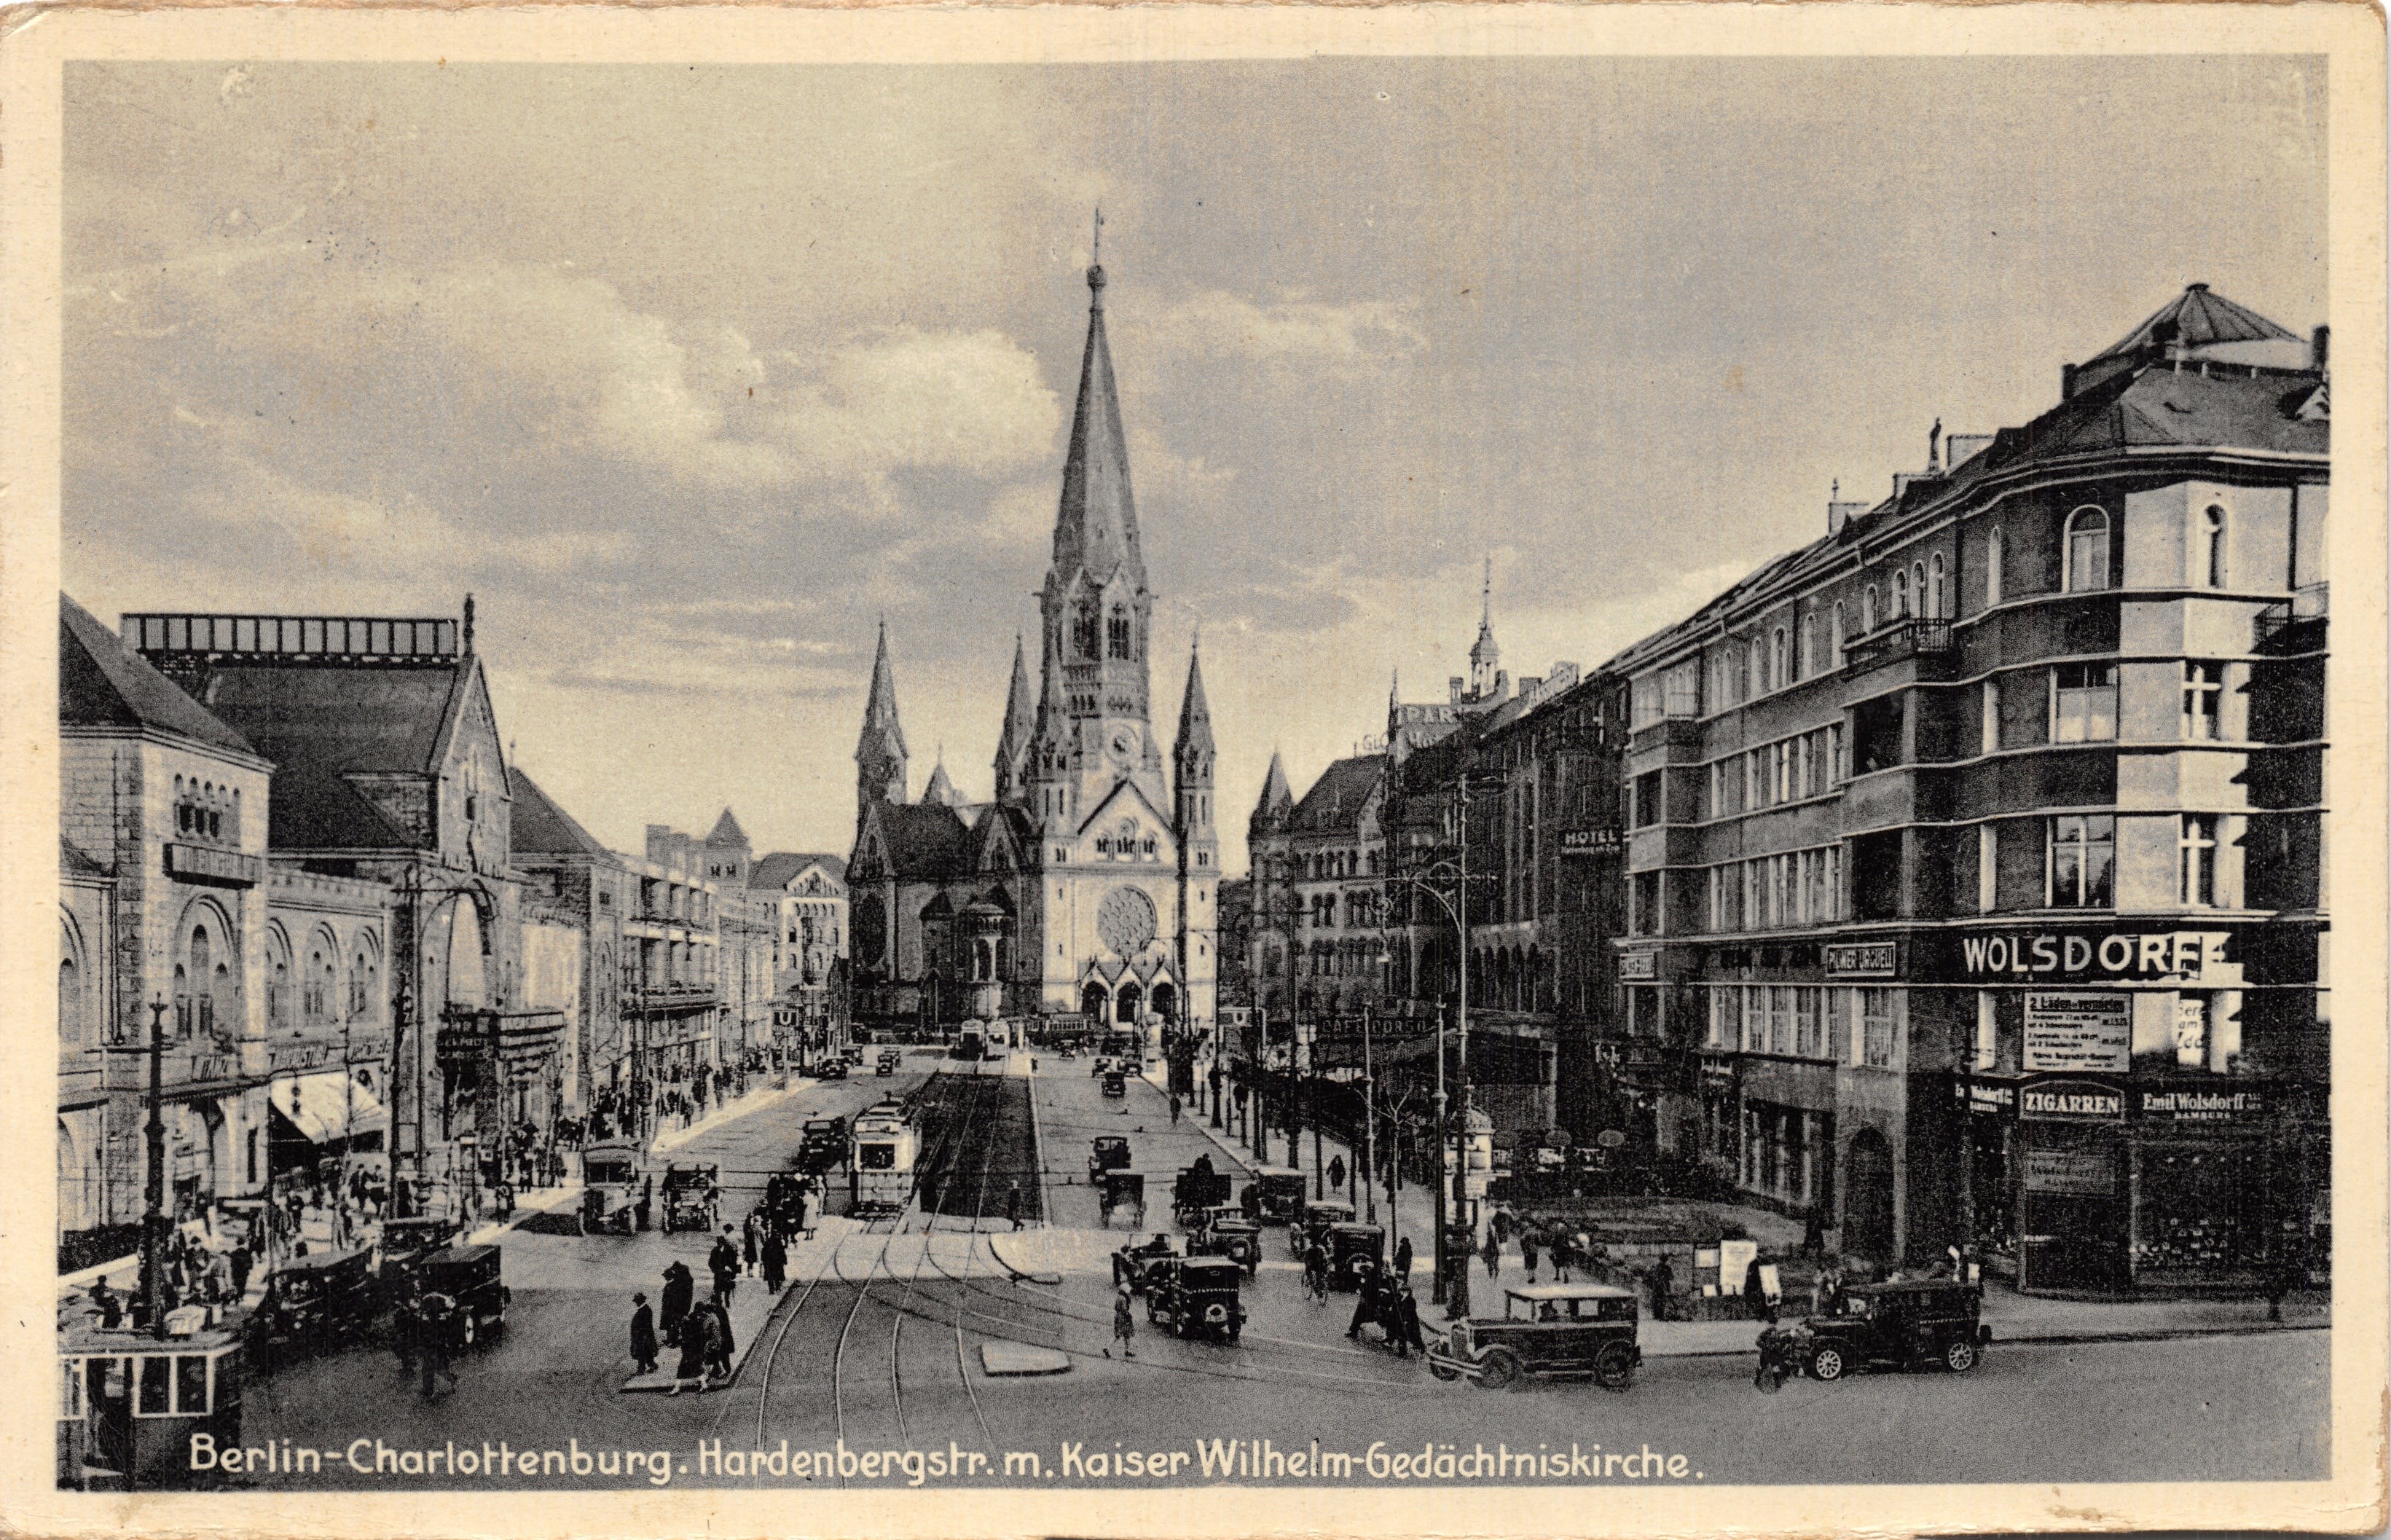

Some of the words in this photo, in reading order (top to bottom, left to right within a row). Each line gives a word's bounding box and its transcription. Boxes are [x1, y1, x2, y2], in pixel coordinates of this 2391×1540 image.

[1564, 828, 1617, 845] HOTEL
[1963, 932, 2231, 973] WOLSDORFF
[779, 1011, 792, 1026] U
[1233, 1012, 1247, 1026] U
[2025, 1093, 2119, 1114] ZIGARREN
[2143, 1092, 2175, 1111] Emil
[2176, 1092, 2245, 1110] Wolsdorff
